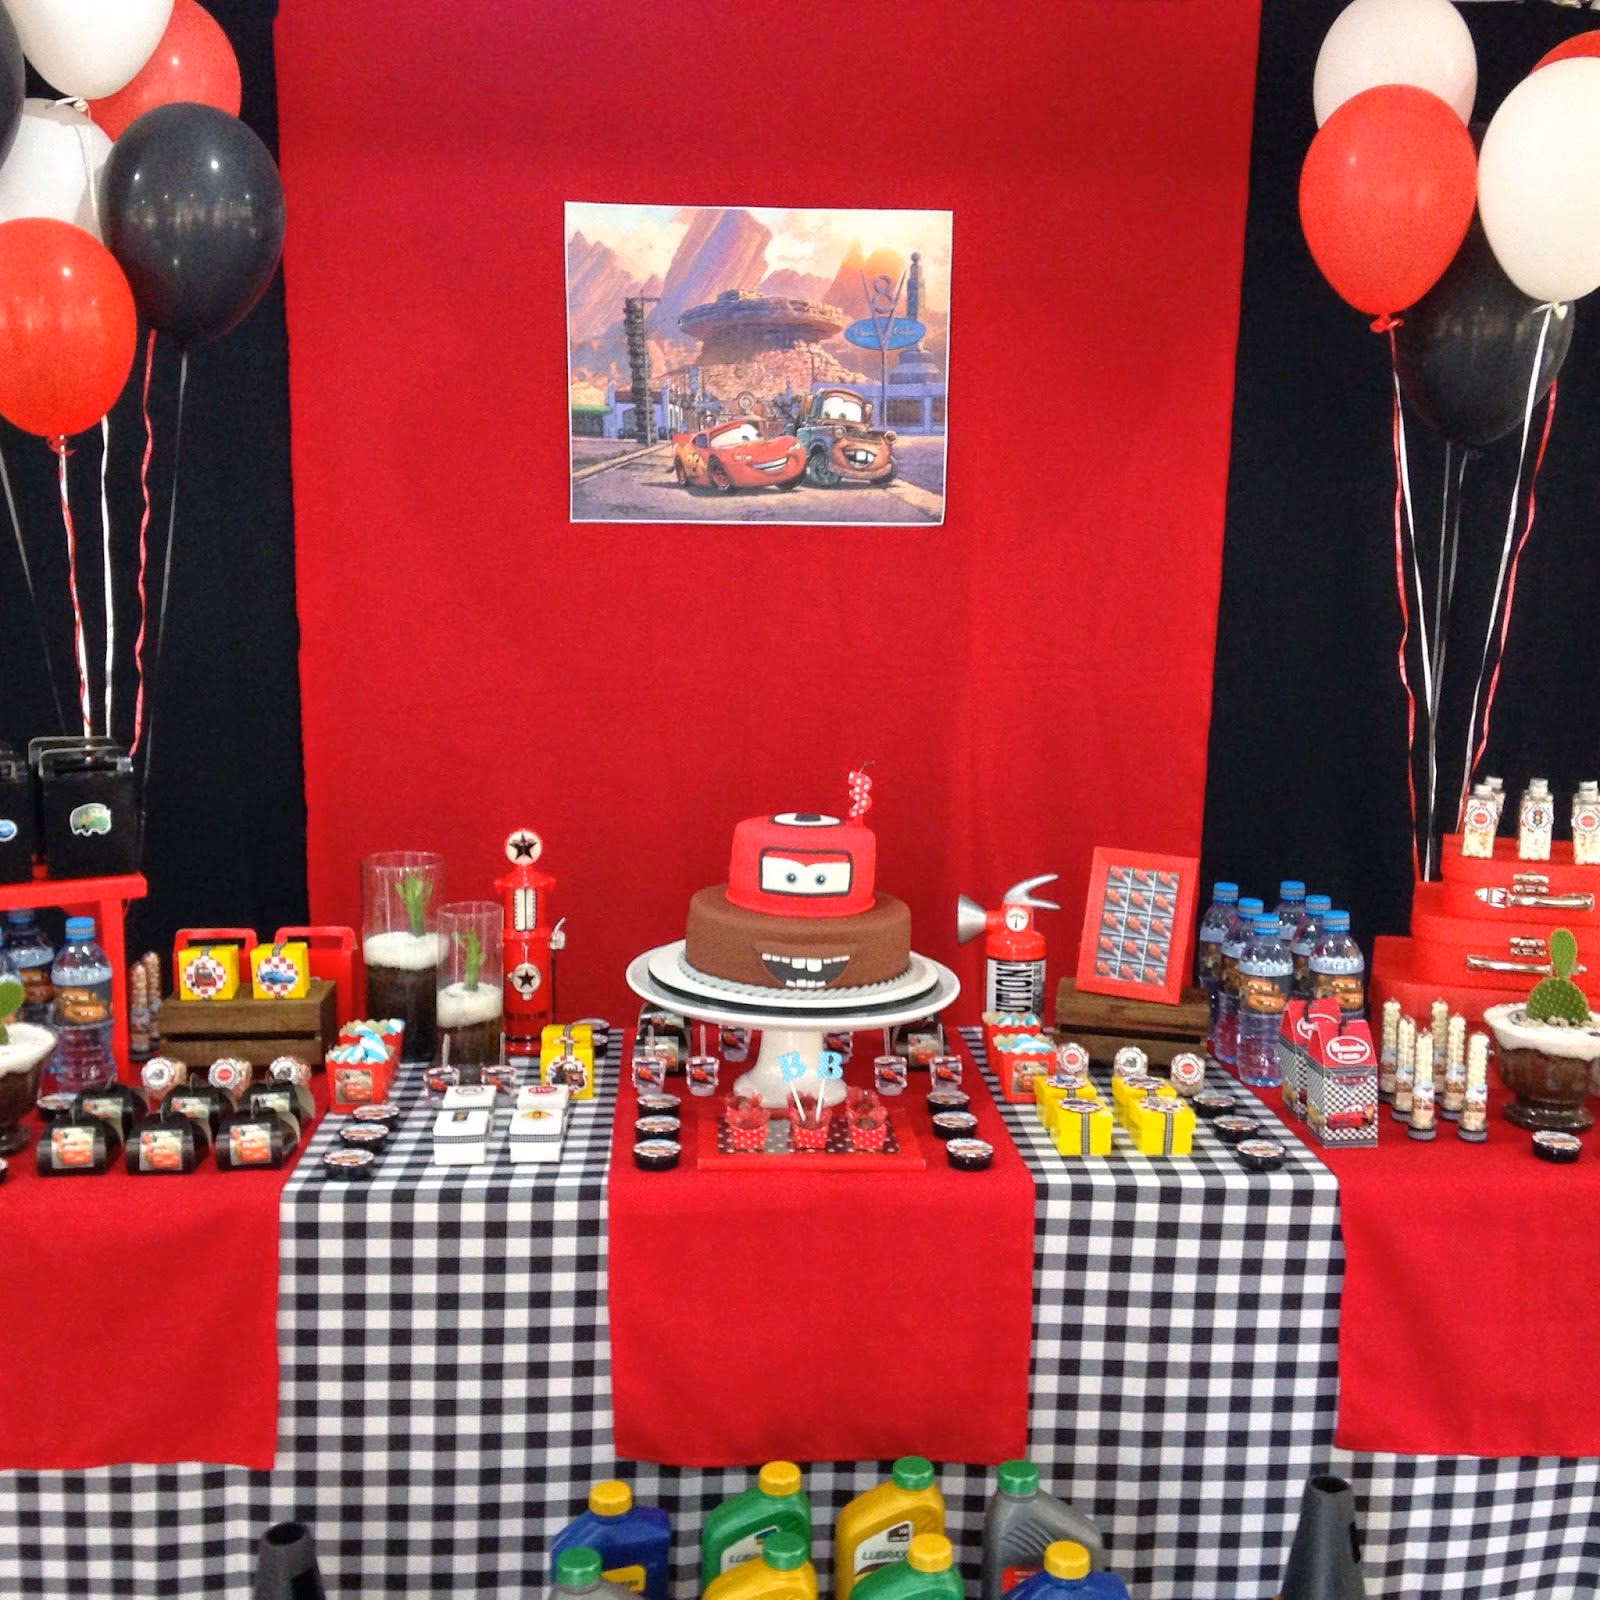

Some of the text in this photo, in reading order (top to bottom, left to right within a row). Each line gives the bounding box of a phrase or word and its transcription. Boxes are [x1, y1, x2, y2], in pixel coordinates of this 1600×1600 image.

[848, 771, 873, 818] 3
[995, 961, 1032, 1013] UTION!
[817, 1051, 844, 1080] B
